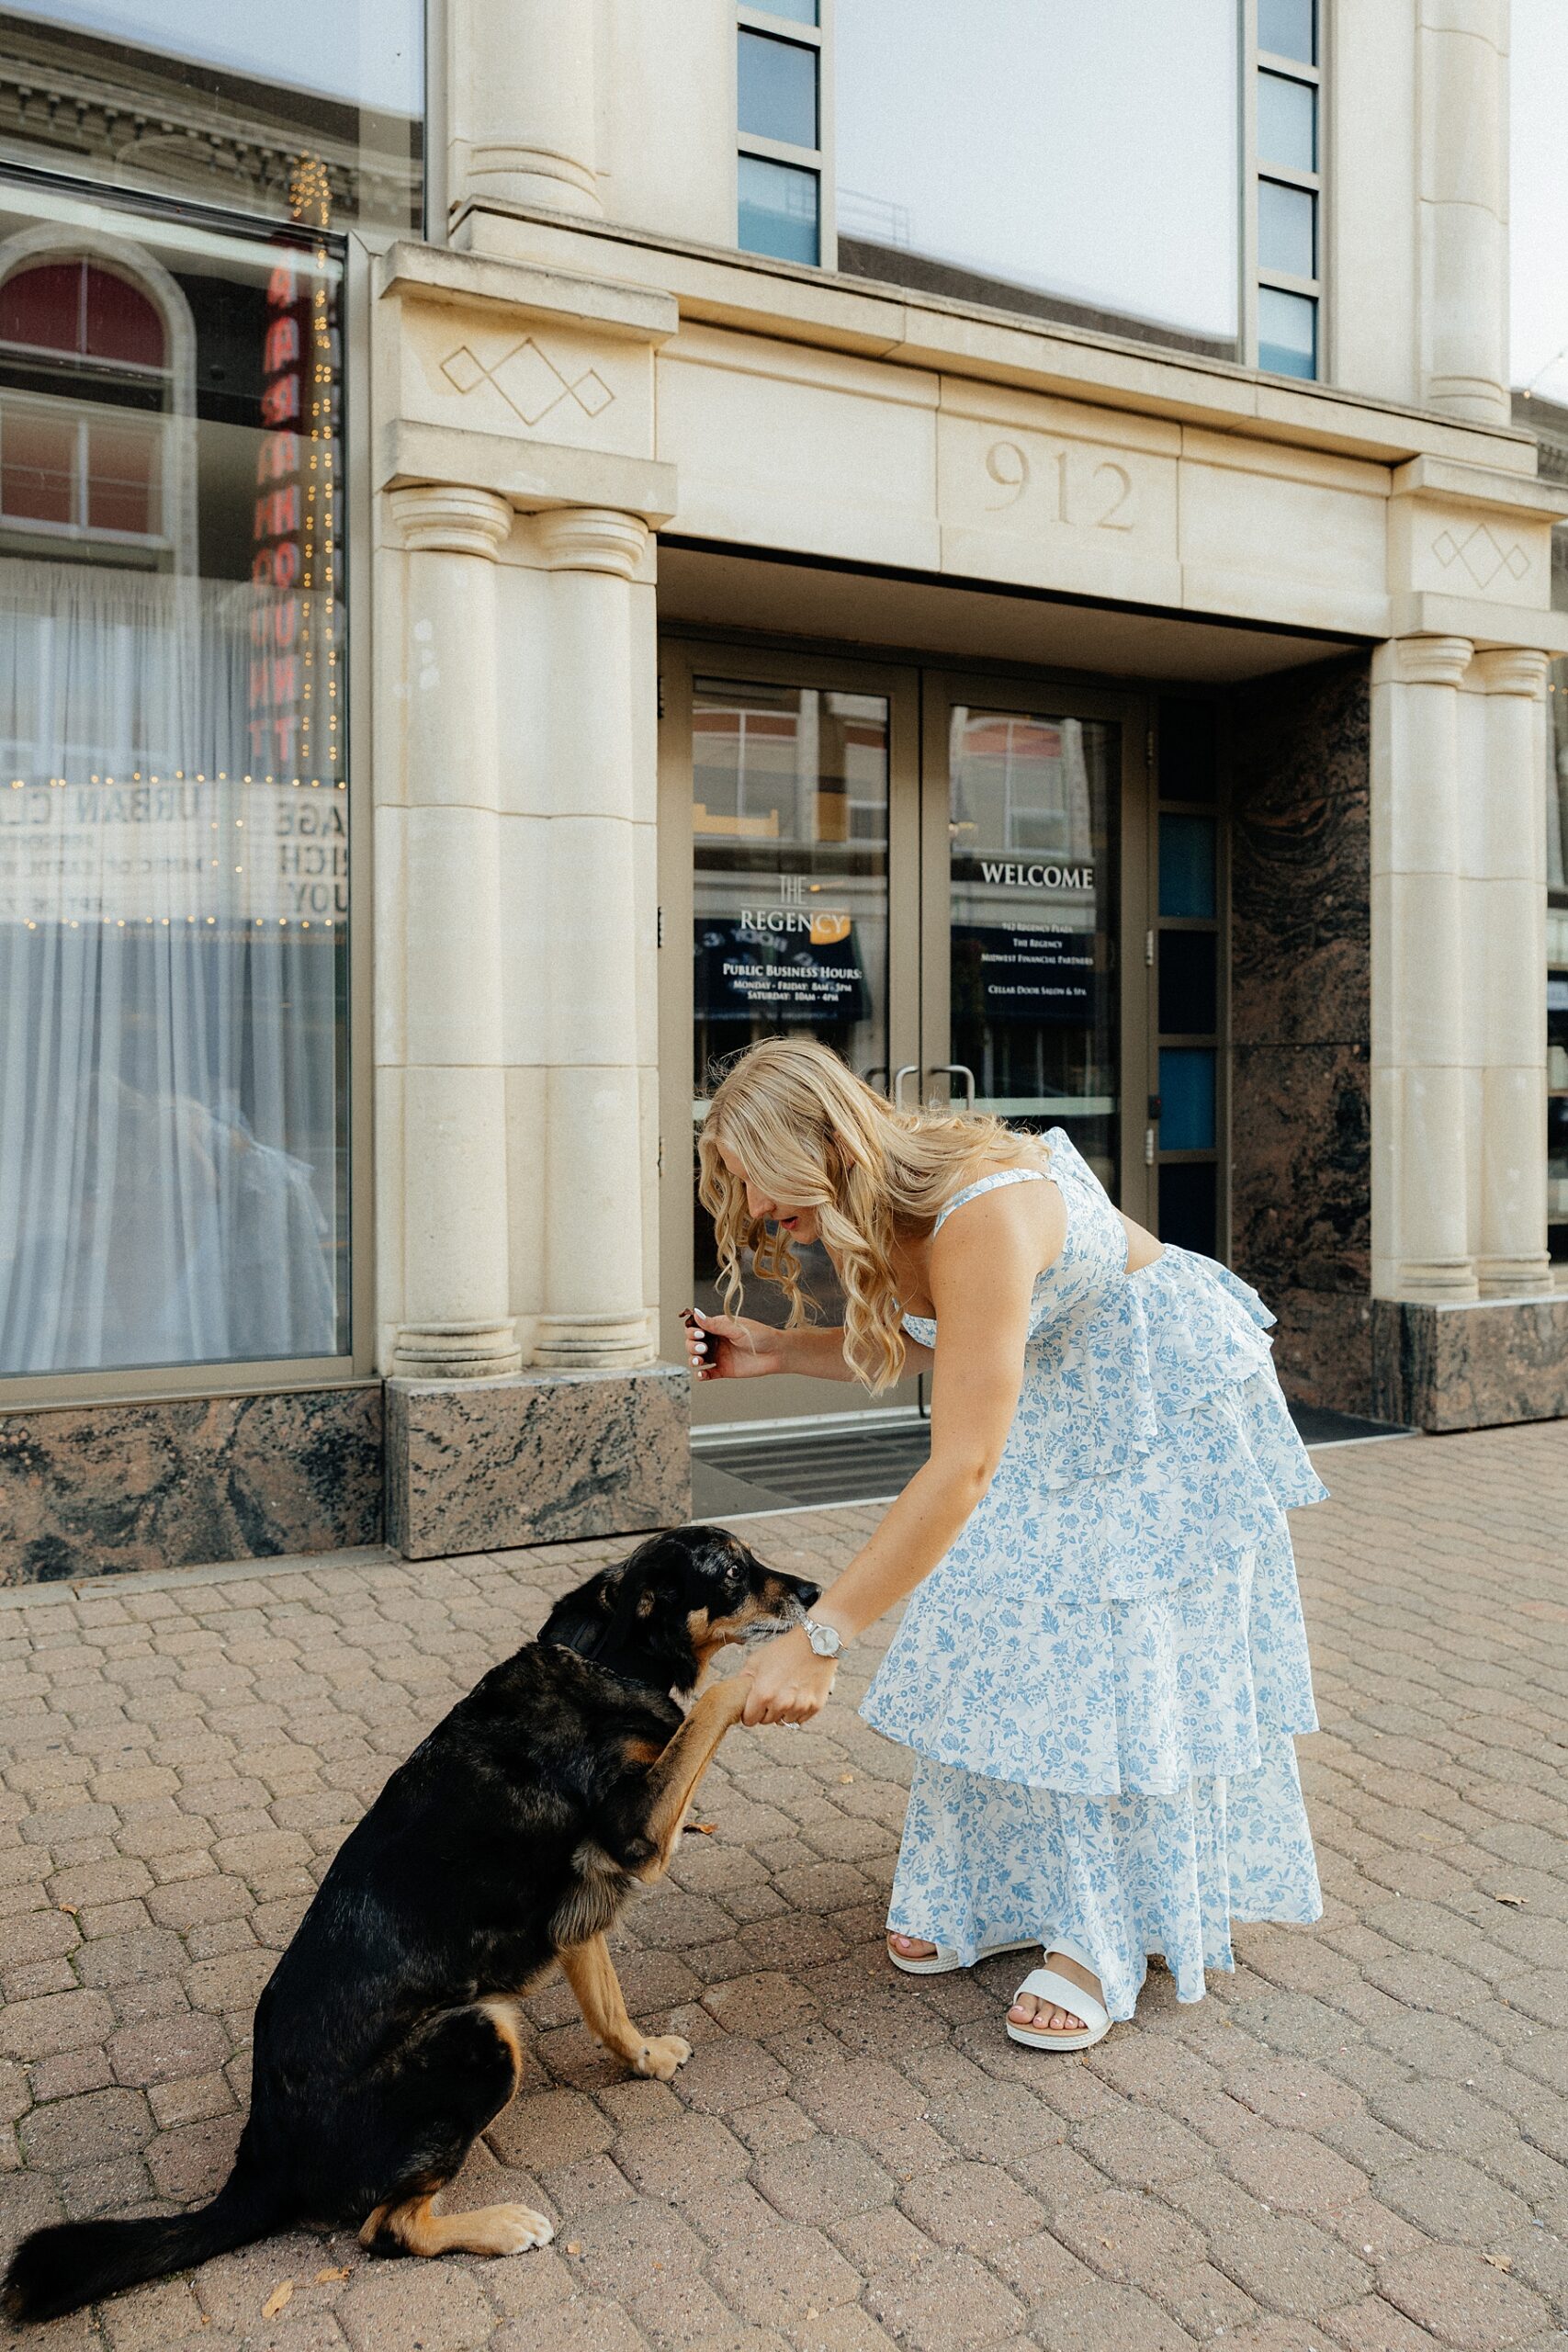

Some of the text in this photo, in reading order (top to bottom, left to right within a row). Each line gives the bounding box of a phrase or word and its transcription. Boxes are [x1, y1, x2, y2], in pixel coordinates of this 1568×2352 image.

[984, 441, 1135, 534] 912
[980, 862, 1094, 889] WELCOME
[779, 875, 807, 905] THE
[740, 910, 846, 933] REGENCY
[1013, 937, 1063, 948] THE REGENCY
[980, 953, 1093, 966] MIDWEST FINANCIAL PARTNERS
[723, 963, 863, 979] PUBLIC BUSINESS HOURS:
[733, 980, 771, 989] MONDAY
[812, 982, 829, 991] 8AM
[987, 985, 1088, 996] CELLAR DOOR SALON & SPA
[795, 991, 816, 1001] 10AM
